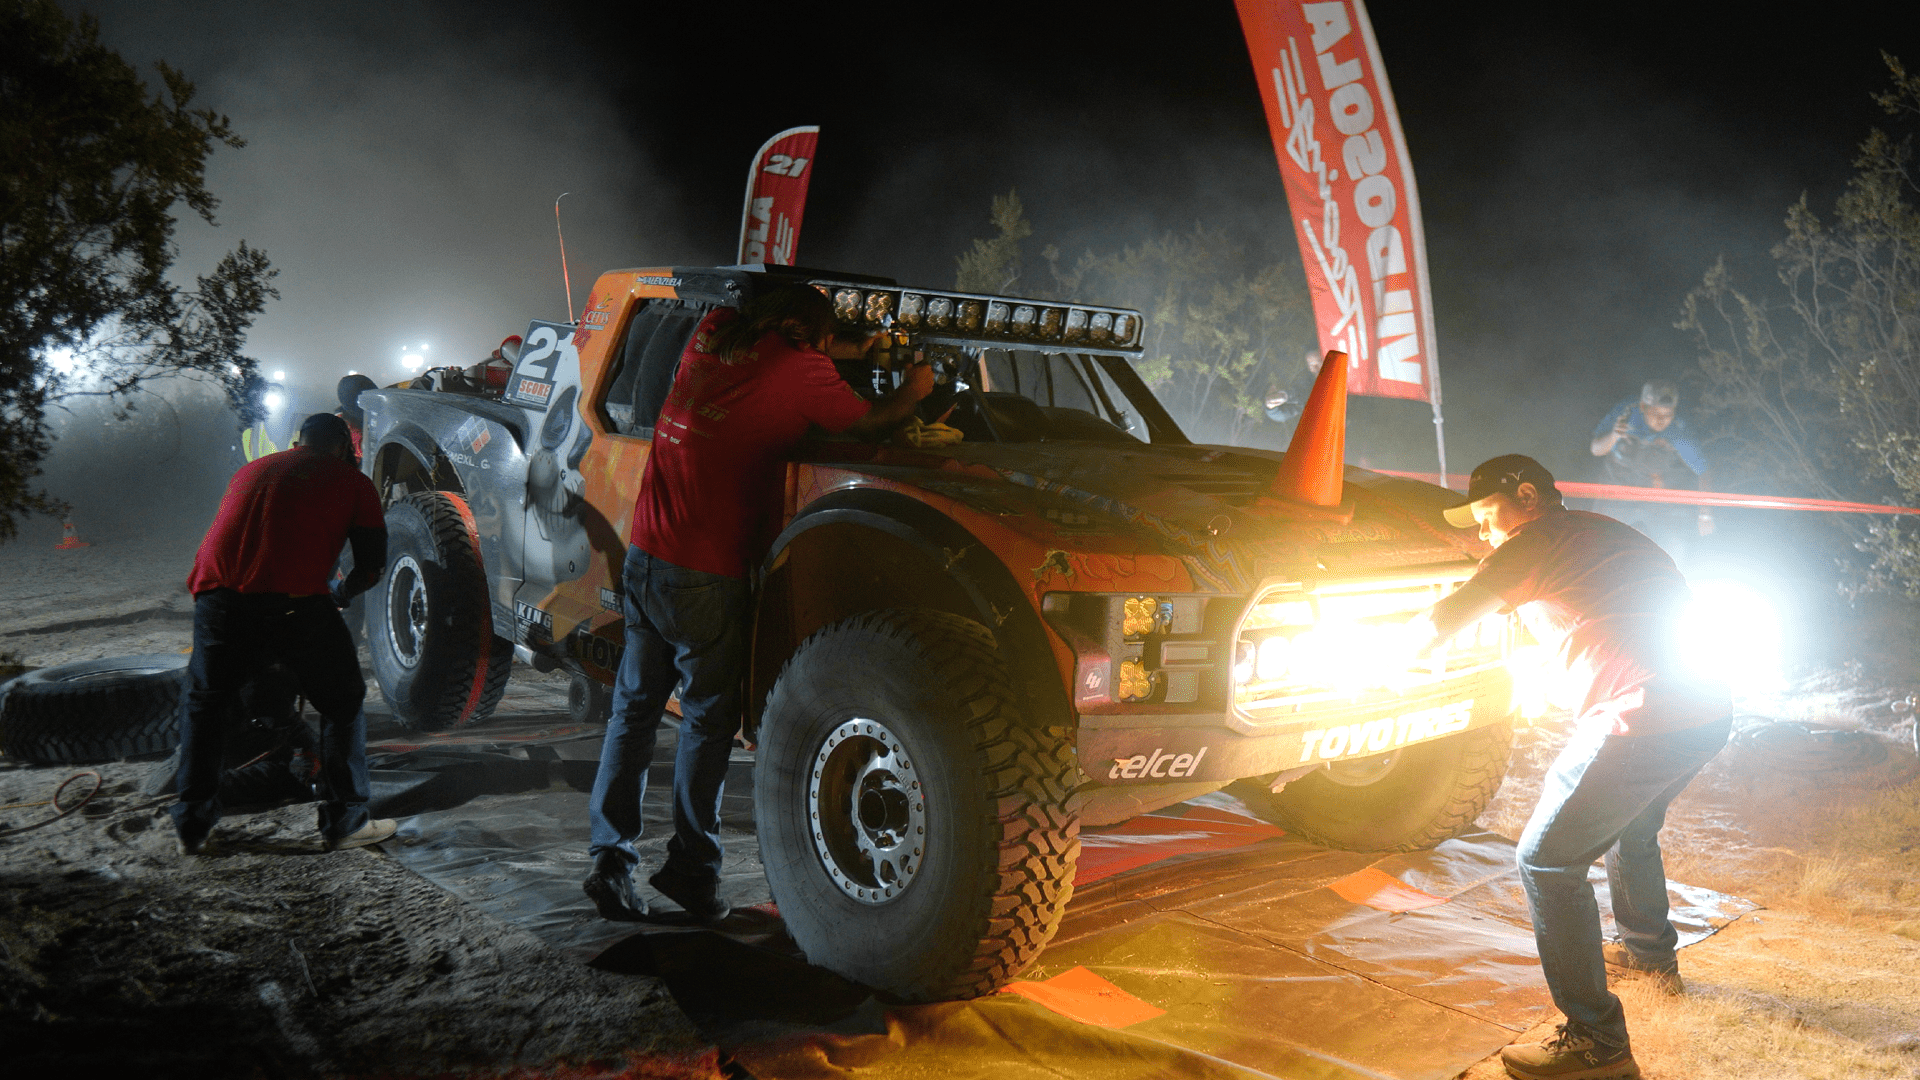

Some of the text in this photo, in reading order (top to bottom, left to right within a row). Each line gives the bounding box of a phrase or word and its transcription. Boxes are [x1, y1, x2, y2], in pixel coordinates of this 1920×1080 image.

[763, 153, 810, 178] 21
[516, 326, 576, 381] 21
[519, 379, 552, 398] SCORE
[518, 602, 552, 628] KING
[1300, 699, 1474, 762] TOYO TIRES
[1108, 746, 1208, 780] telcel
